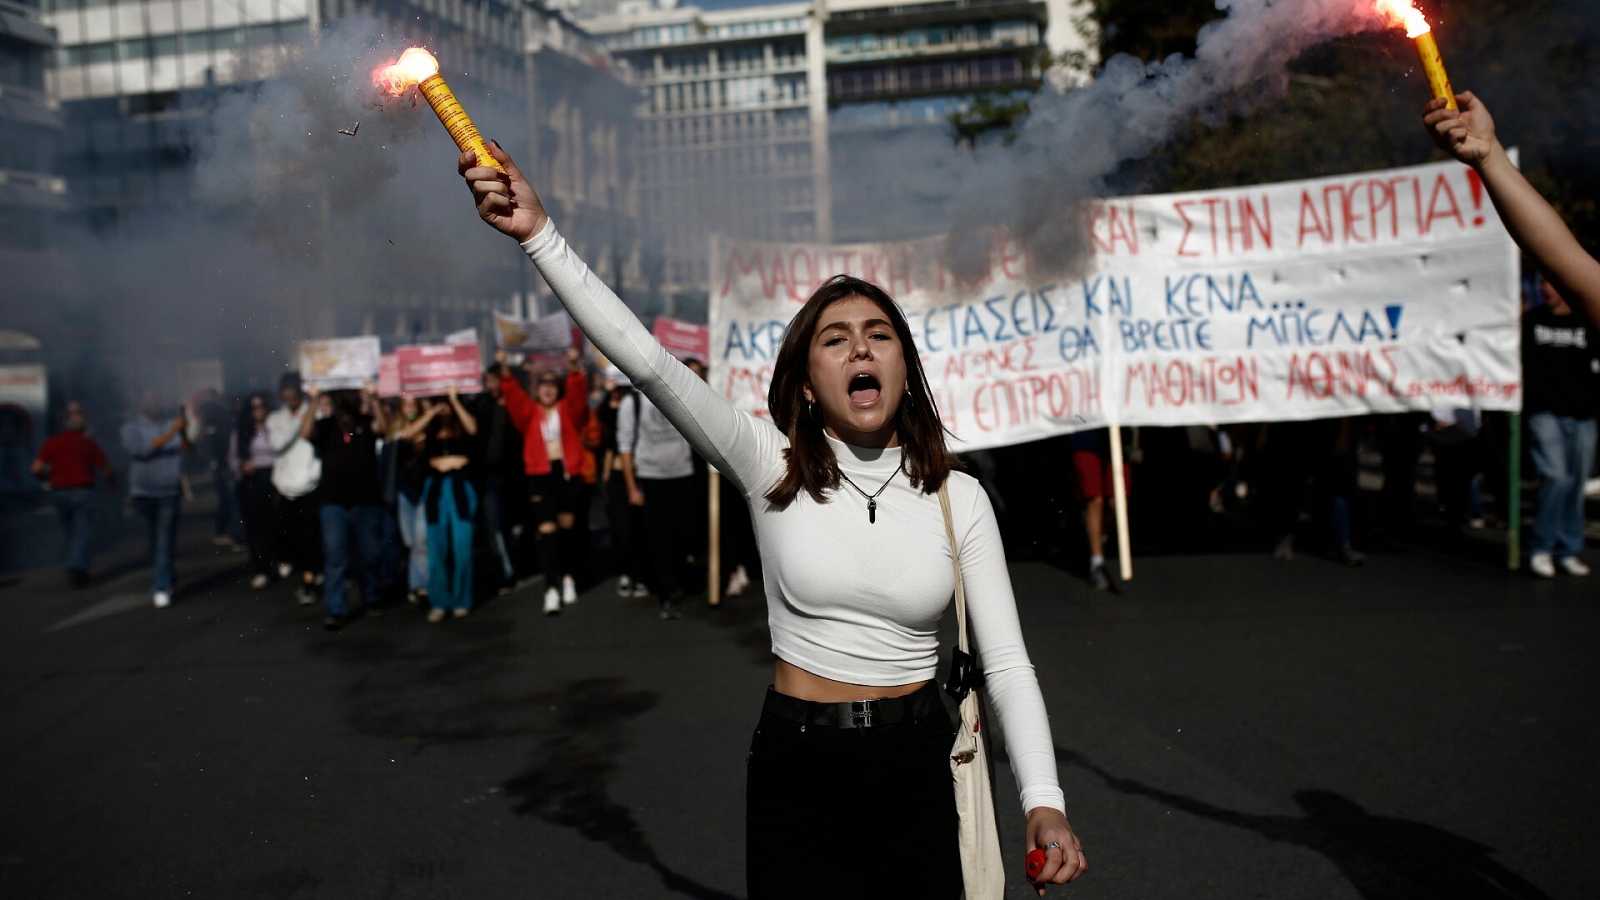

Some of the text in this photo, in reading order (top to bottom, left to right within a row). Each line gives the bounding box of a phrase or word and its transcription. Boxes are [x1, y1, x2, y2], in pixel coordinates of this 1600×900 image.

[1088, 167, 1485, 256] ΚΑΙ ΣΤΗΝ ΑΠΕΡΓΙΑ!
[1082, 273, 1131, 317] ΚΑΙ
[1060, 326, 1100, 362] ΘΑ
[1119, 319, 1213, 351] ΒΡΕΙΤΕ
[1247, 305, 1402, 346] ΜΠΕΛΑ!
[974, 364, 1101, 432] ΕΠΙΤΡΟΠΗ
[1287, 346, 1402, 400] ΑΘΗΝΑΣ
